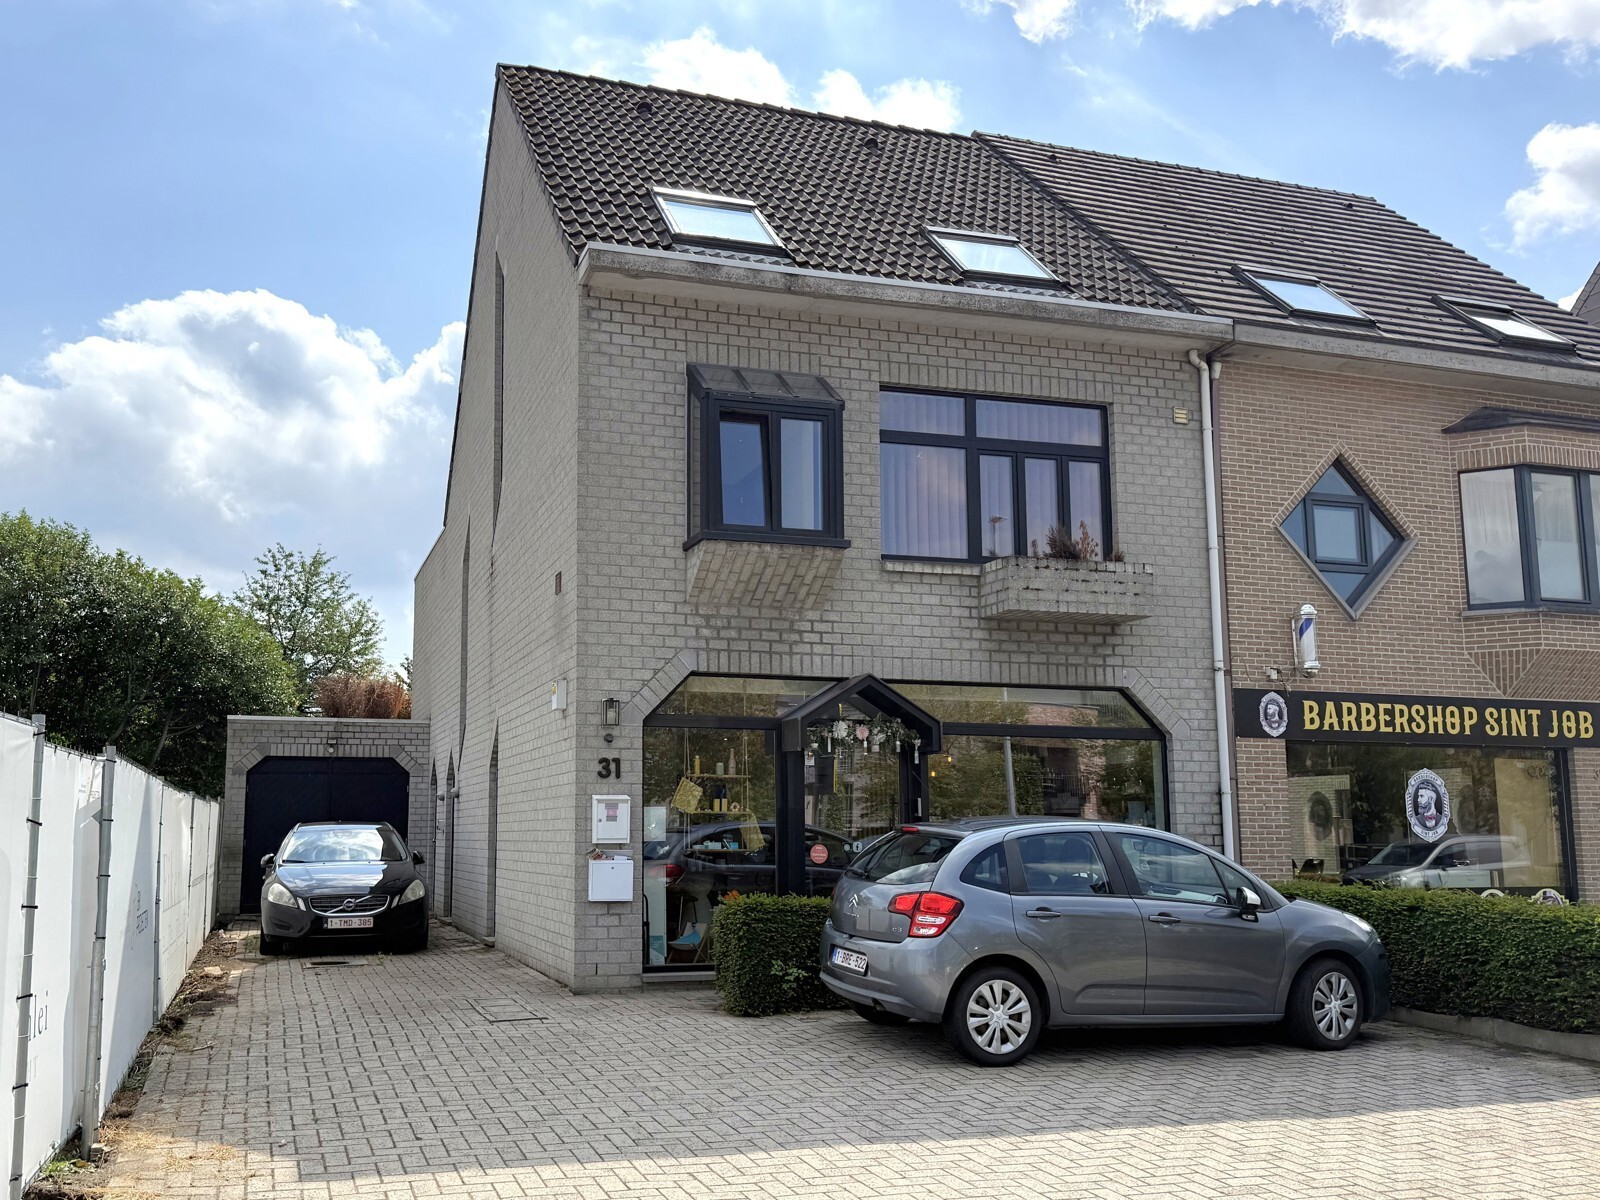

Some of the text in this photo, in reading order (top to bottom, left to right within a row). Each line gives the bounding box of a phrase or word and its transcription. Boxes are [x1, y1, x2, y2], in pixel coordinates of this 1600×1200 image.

[1302, 700, 1594, 739] BARBERSHOP SINT JOB
[597, 757, 621, 779] 31
[329, 918, 372, 927] 1-TMD-385
[836, 950, 868, 970] 1-BRE-522
